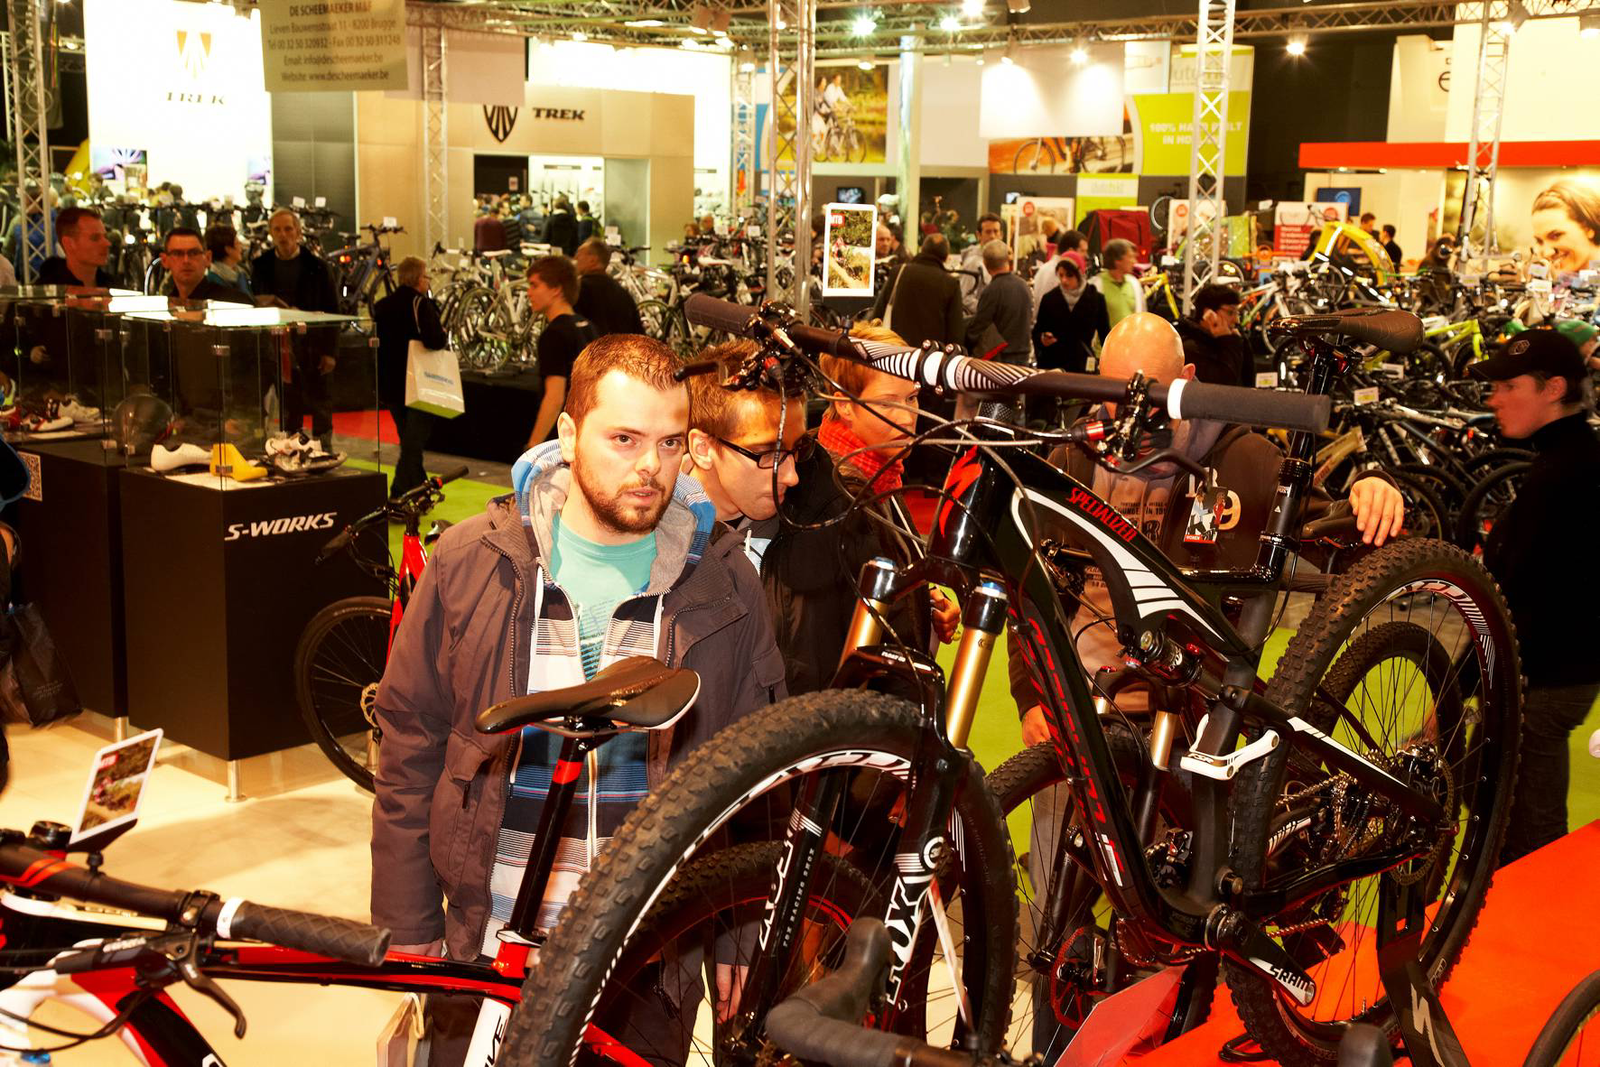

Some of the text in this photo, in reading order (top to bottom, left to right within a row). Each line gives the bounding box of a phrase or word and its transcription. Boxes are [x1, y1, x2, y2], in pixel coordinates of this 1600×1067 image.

[289, 5, 300, 17] DE
[300, 2, 354, 16] SCHEEMAEKER
[269, 23, 290, 35] Lieven
[371, 18, 397, 31] Brugge
[332, 36, 345, 47] Fax
[532, 107, 585, 121] TREK
[1068, 487, 1138, 543] SPECIALIZED
[224, 512, 338, 541] S-WORKS
[782, 847, 816, 948] FOX RACING SHOX
[1269, 965, 1312, 993] SRAM
